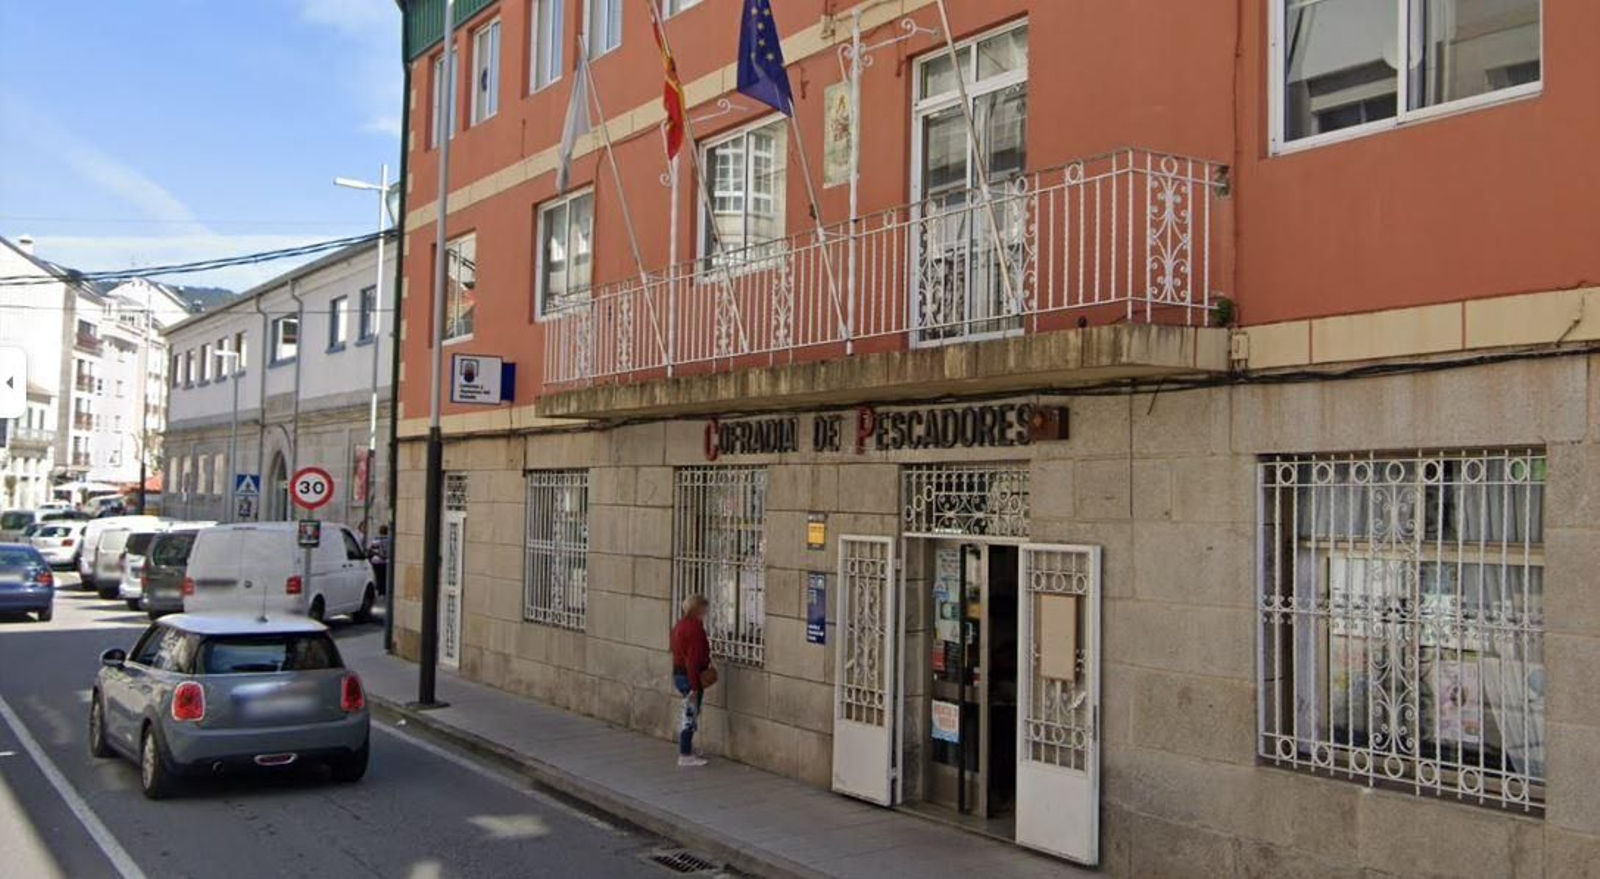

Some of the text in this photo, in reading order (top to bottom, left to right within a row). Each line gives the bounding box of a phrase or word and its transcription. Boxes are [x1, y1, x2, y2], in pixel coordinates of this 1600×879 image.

[704, 405, 1033, 461] COFRADIA DE PESCADORES
[299, 480, 325, 495] 30
